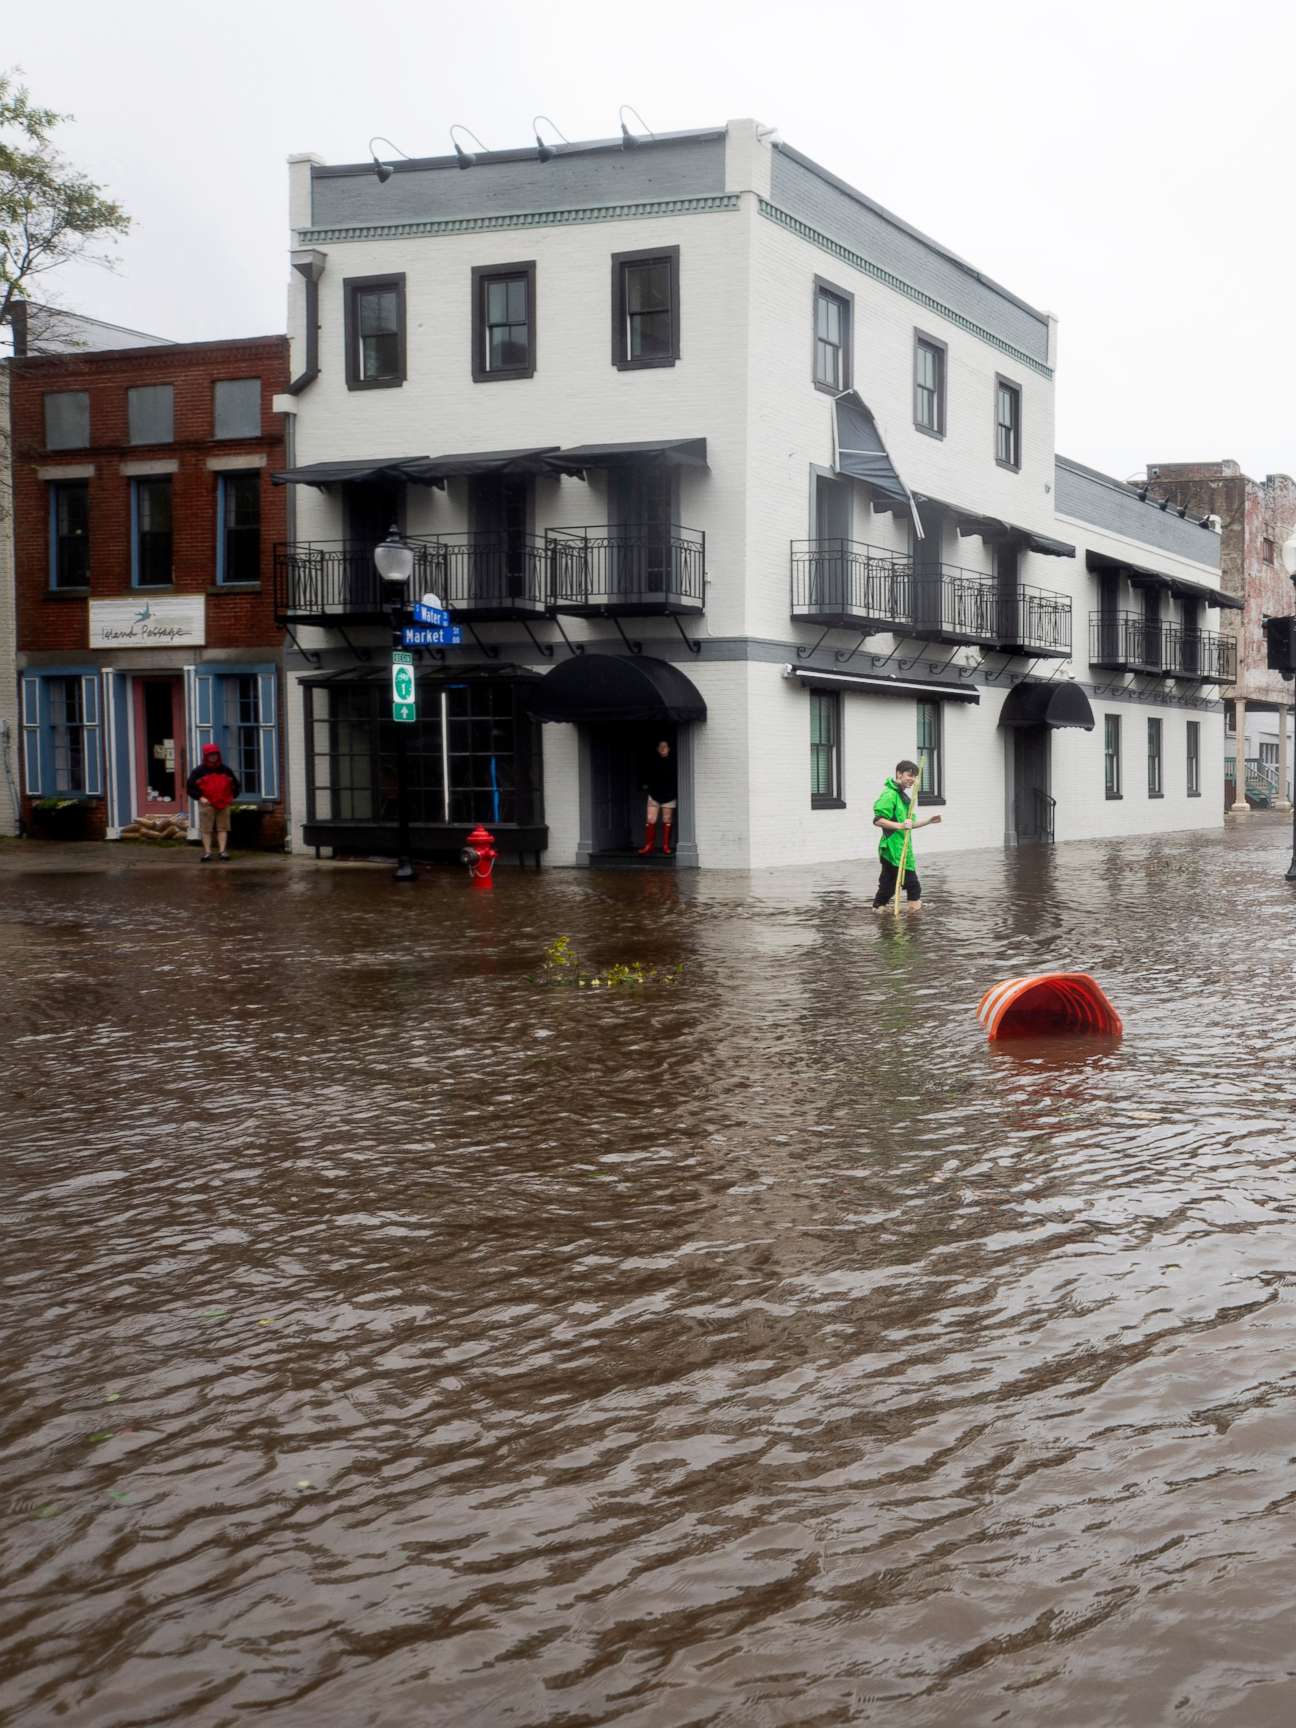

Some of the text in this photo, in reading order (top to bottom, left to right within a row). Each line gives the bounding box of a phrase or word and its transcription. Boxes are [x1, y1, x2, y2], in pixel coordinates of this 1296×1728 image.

[421, 607, 441, 624] Water
[141, 624, 193, 640] Passage
[406, 629, 444, 643] Market
